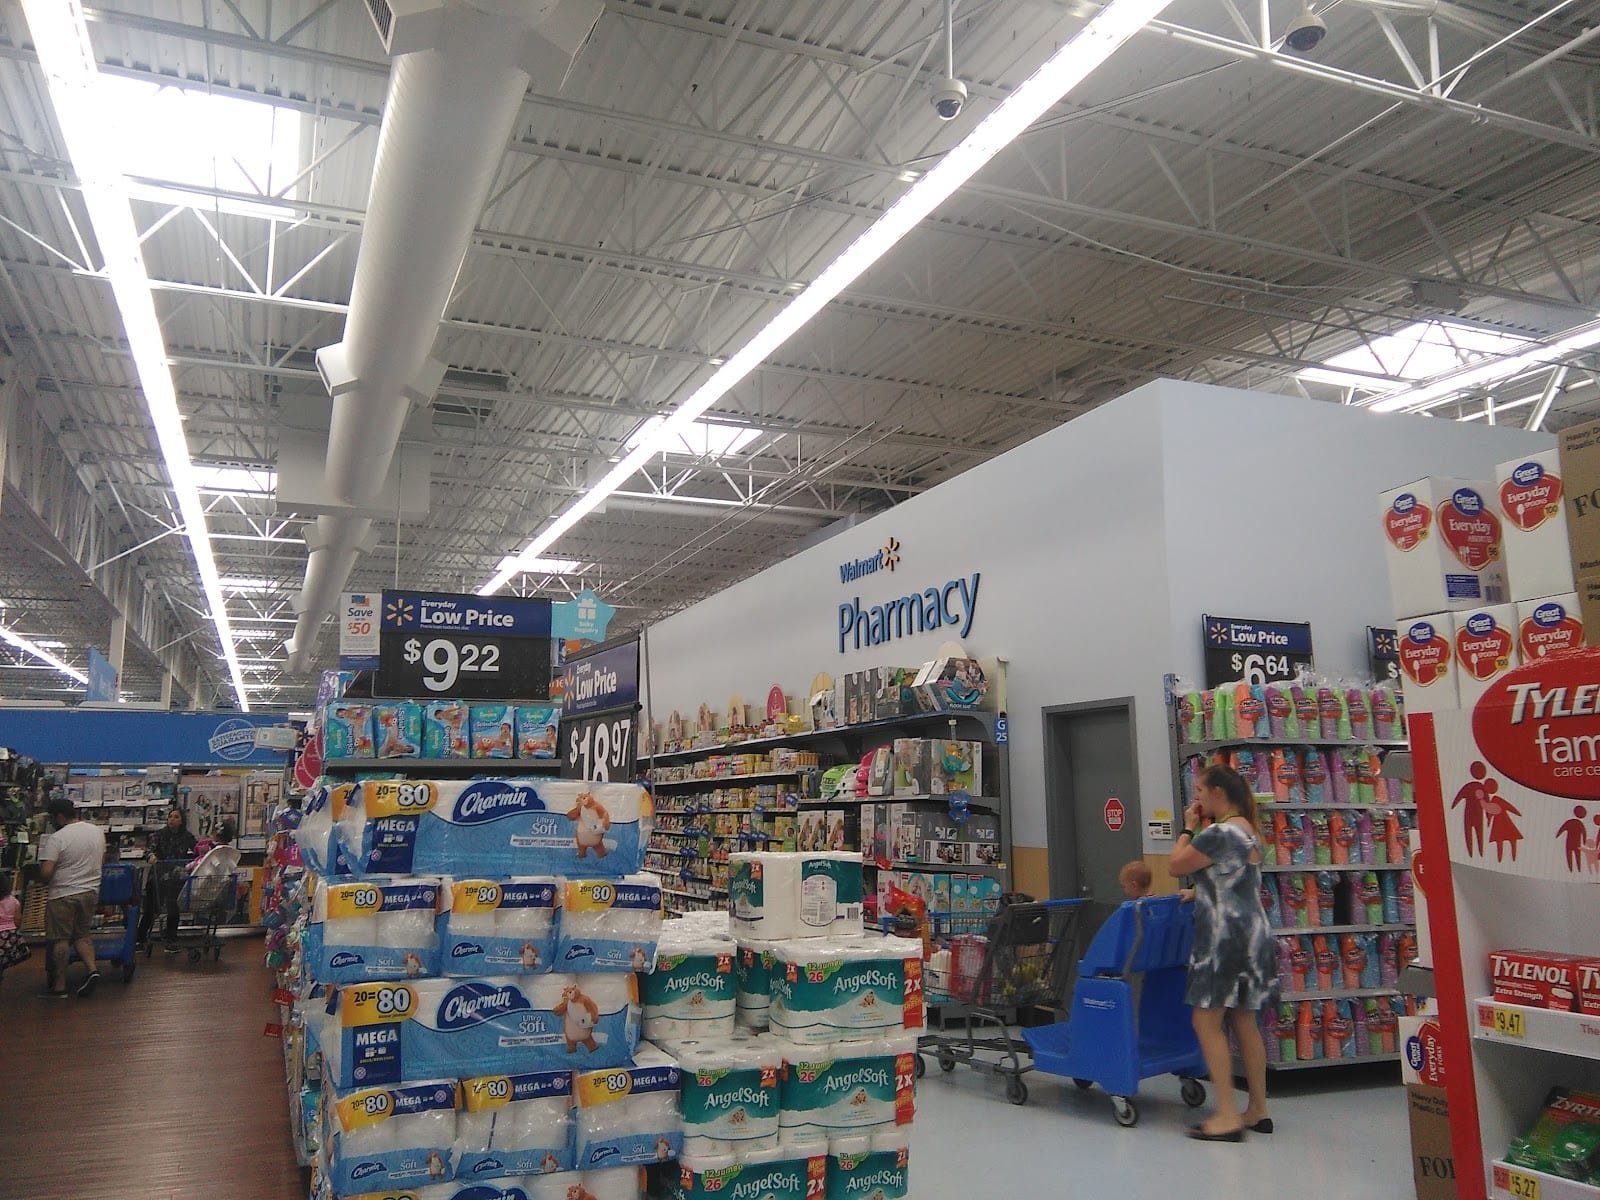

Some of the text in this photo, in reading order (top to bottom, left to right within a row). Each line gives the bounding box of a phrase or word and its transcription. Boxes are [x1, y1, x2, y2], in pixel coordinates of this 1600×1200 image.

[1515, 466, 1540, 479] Great
[1455, 493, 1479, 505] Great
[1507, 486, 1551, 504] Everyday
[1391, 514, 1422, 529] Everyday
[1449, 519, 1492, 535] Everyday
[840, 549, 884, 584] Walmart
[421, 600, 457, 610] Everyday
[347, 607, 374, 617] Save
[420, 609, 462, 626] Low
[465, 609, 515, 628] Price
[838, 572, 981, 654] Pharmacy
[1535, 607, 1560, 619] Great
[347, 622, 371, 635] $50
[1468, 618, 1491, 628] Great
[1410, 626, 1430, 636] Great
[1528, 628, 1573, 644] Everyday
[1231, 631, 1256, 644] Low
[1258, 631, 1289, 646] Price
[1462, 637, 1501, 652] Everyday
[1405, 645, 1441, 659] Everyday
[576, 665, 617, 701] Low Price
[1506, 682, 1600, 725] TYLE
[997, 720, 1006, 730] G
[995, 732, 1007, 742] 25
[1553, 766, 1584, 777] care
[460, 786, 528, 817] Charmin
[1107, 809, 1122, 817] STOP
[376, 819, 417, 832] MEGA
[531, 821, 558, 836] Soft
[384, 894, 411, 904] MEGA
[503, 892, 529, 901] MEGA
[616, 891, 640, 901] MEGA
[659, 962, 672, 971] 26
[1490, 955, 1570, 985] TYLENOL
[807, 972, 824, 983] 26
[1495, 987, 1544, 1001] Extra Strength
[444, 988, 513, 1023] Charmin
[522, 1014, 542, 1023] Ultra
[518, 1020, 546, 1034] Soft
[356, 1029, 398, 1047] MEGA
[1425, 1035, 1438, 1082] Everyday
[633, 1075, 658, 1087] MEGA
[699, 1076, 712, 1086] 26
[800, 1071, 816, 1082] 26
[514, 1081, 540, 1094] MEGA
[395, 1096, 422, 1108] MEGA
[840, 1160, 854, 1170] 26
[705, 1169, 716, 1178] 12
[704, 1178, 722, 1192] 26
